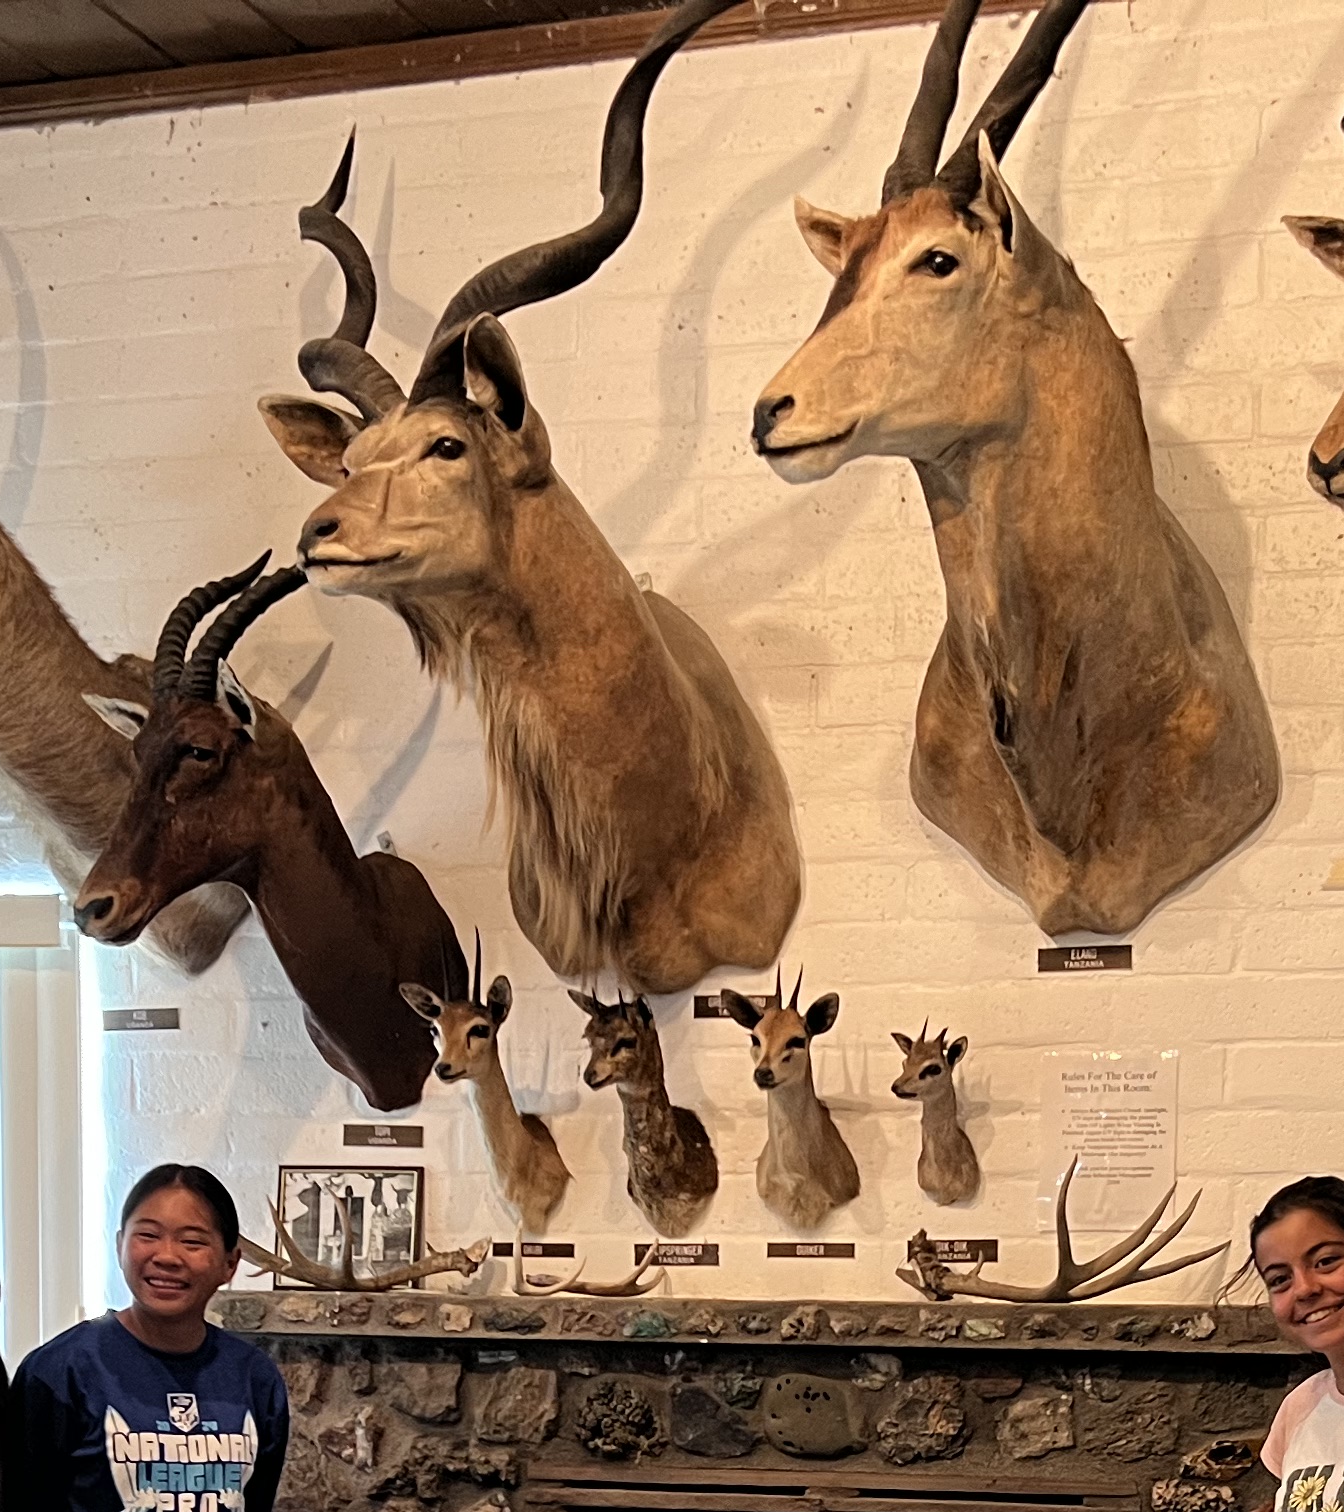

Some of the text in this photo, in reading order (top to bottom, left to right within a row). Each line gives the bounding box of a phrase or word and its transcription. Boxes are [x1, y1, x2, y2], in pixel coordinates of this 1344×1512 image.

[1070, 948, 1097, 961] ELAND
[1063, 960, 1105, 969] TANZANIA
[1061, 1070, 1158, 1081] Rules For The Care of
[1102, 1084, 1121, 1093] This
[138, 1462, 241, 1492] LEAGUE
